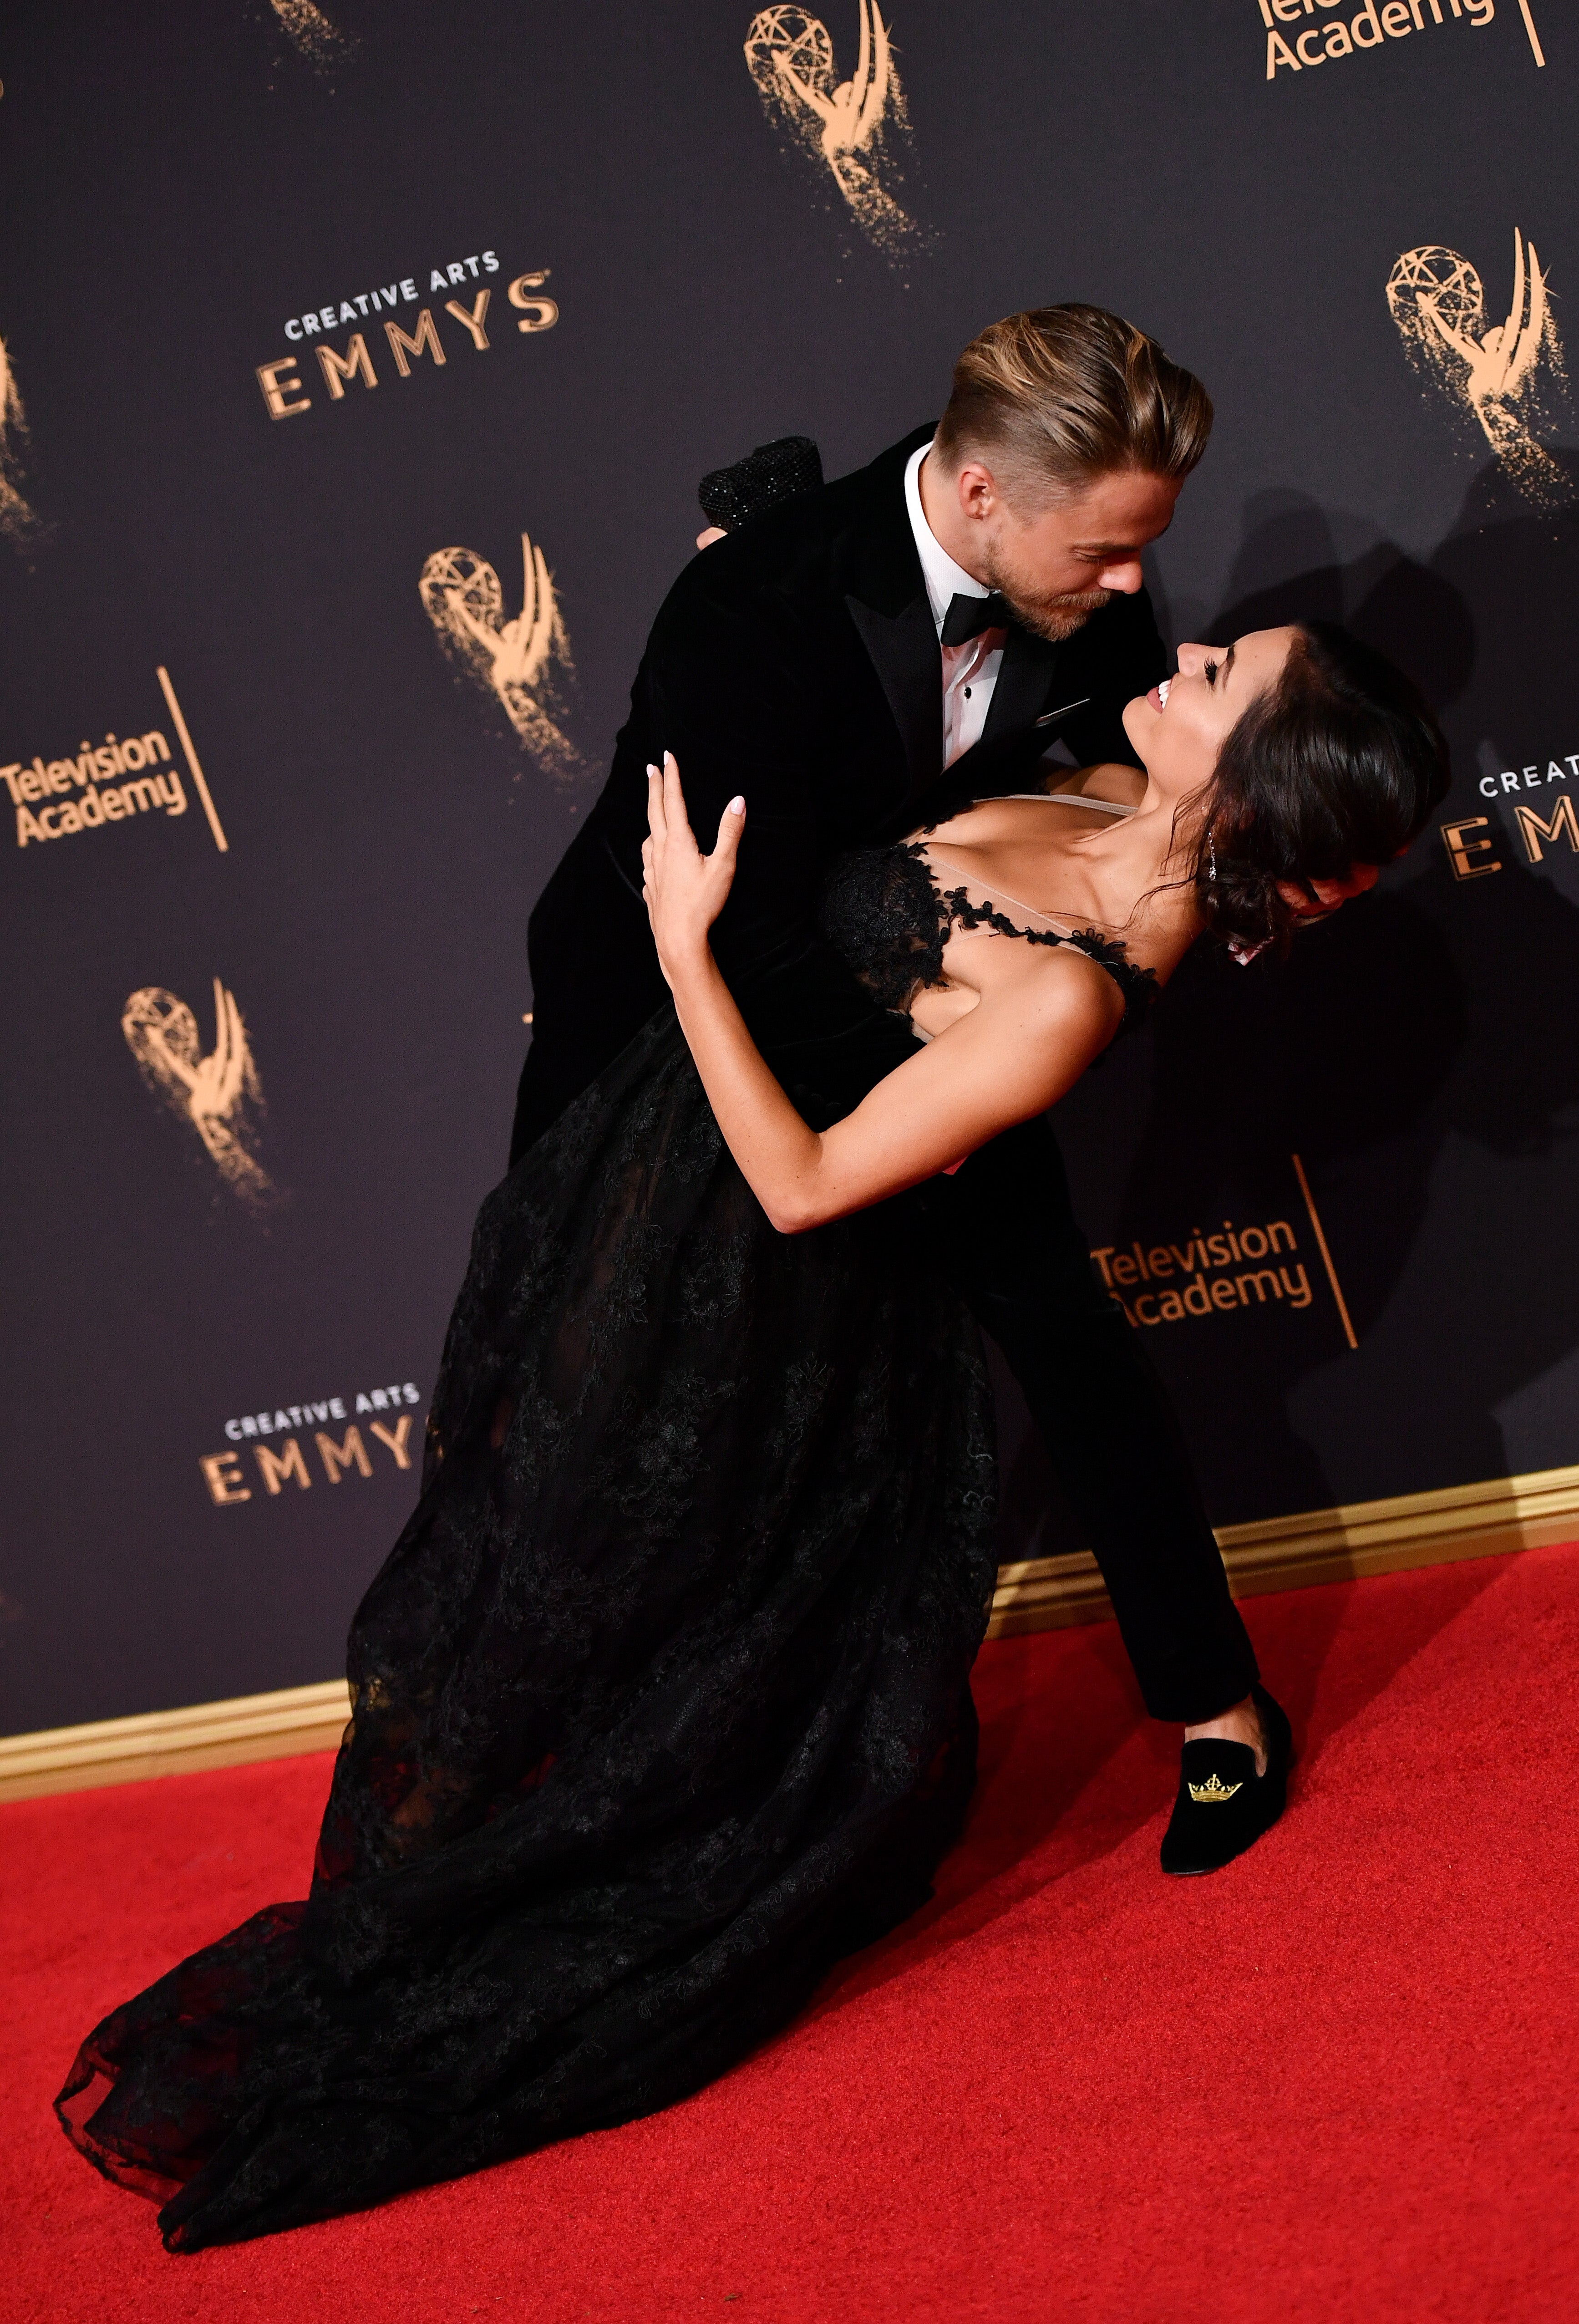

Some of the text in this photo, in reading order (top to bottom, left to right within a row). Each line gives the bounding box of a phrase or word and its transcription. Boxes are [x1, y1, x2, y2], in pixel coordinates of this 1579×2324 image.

[284, 250, 500, 341] CREATIVE ARTS
[256, 269, 559, 420] EMMYS
[0, 732, 172, 805] Television
[1479, 754, 1579, 797] CREAT
[16, 770, 188, 848] Academy
[1440, 795, 1579, 881] EM
[1090, 1221, 1297, 1287] Television
[224, 1382, 420, 1441] CREATIVE ARTS
[200, 1414, 443, 1506] EMMY
